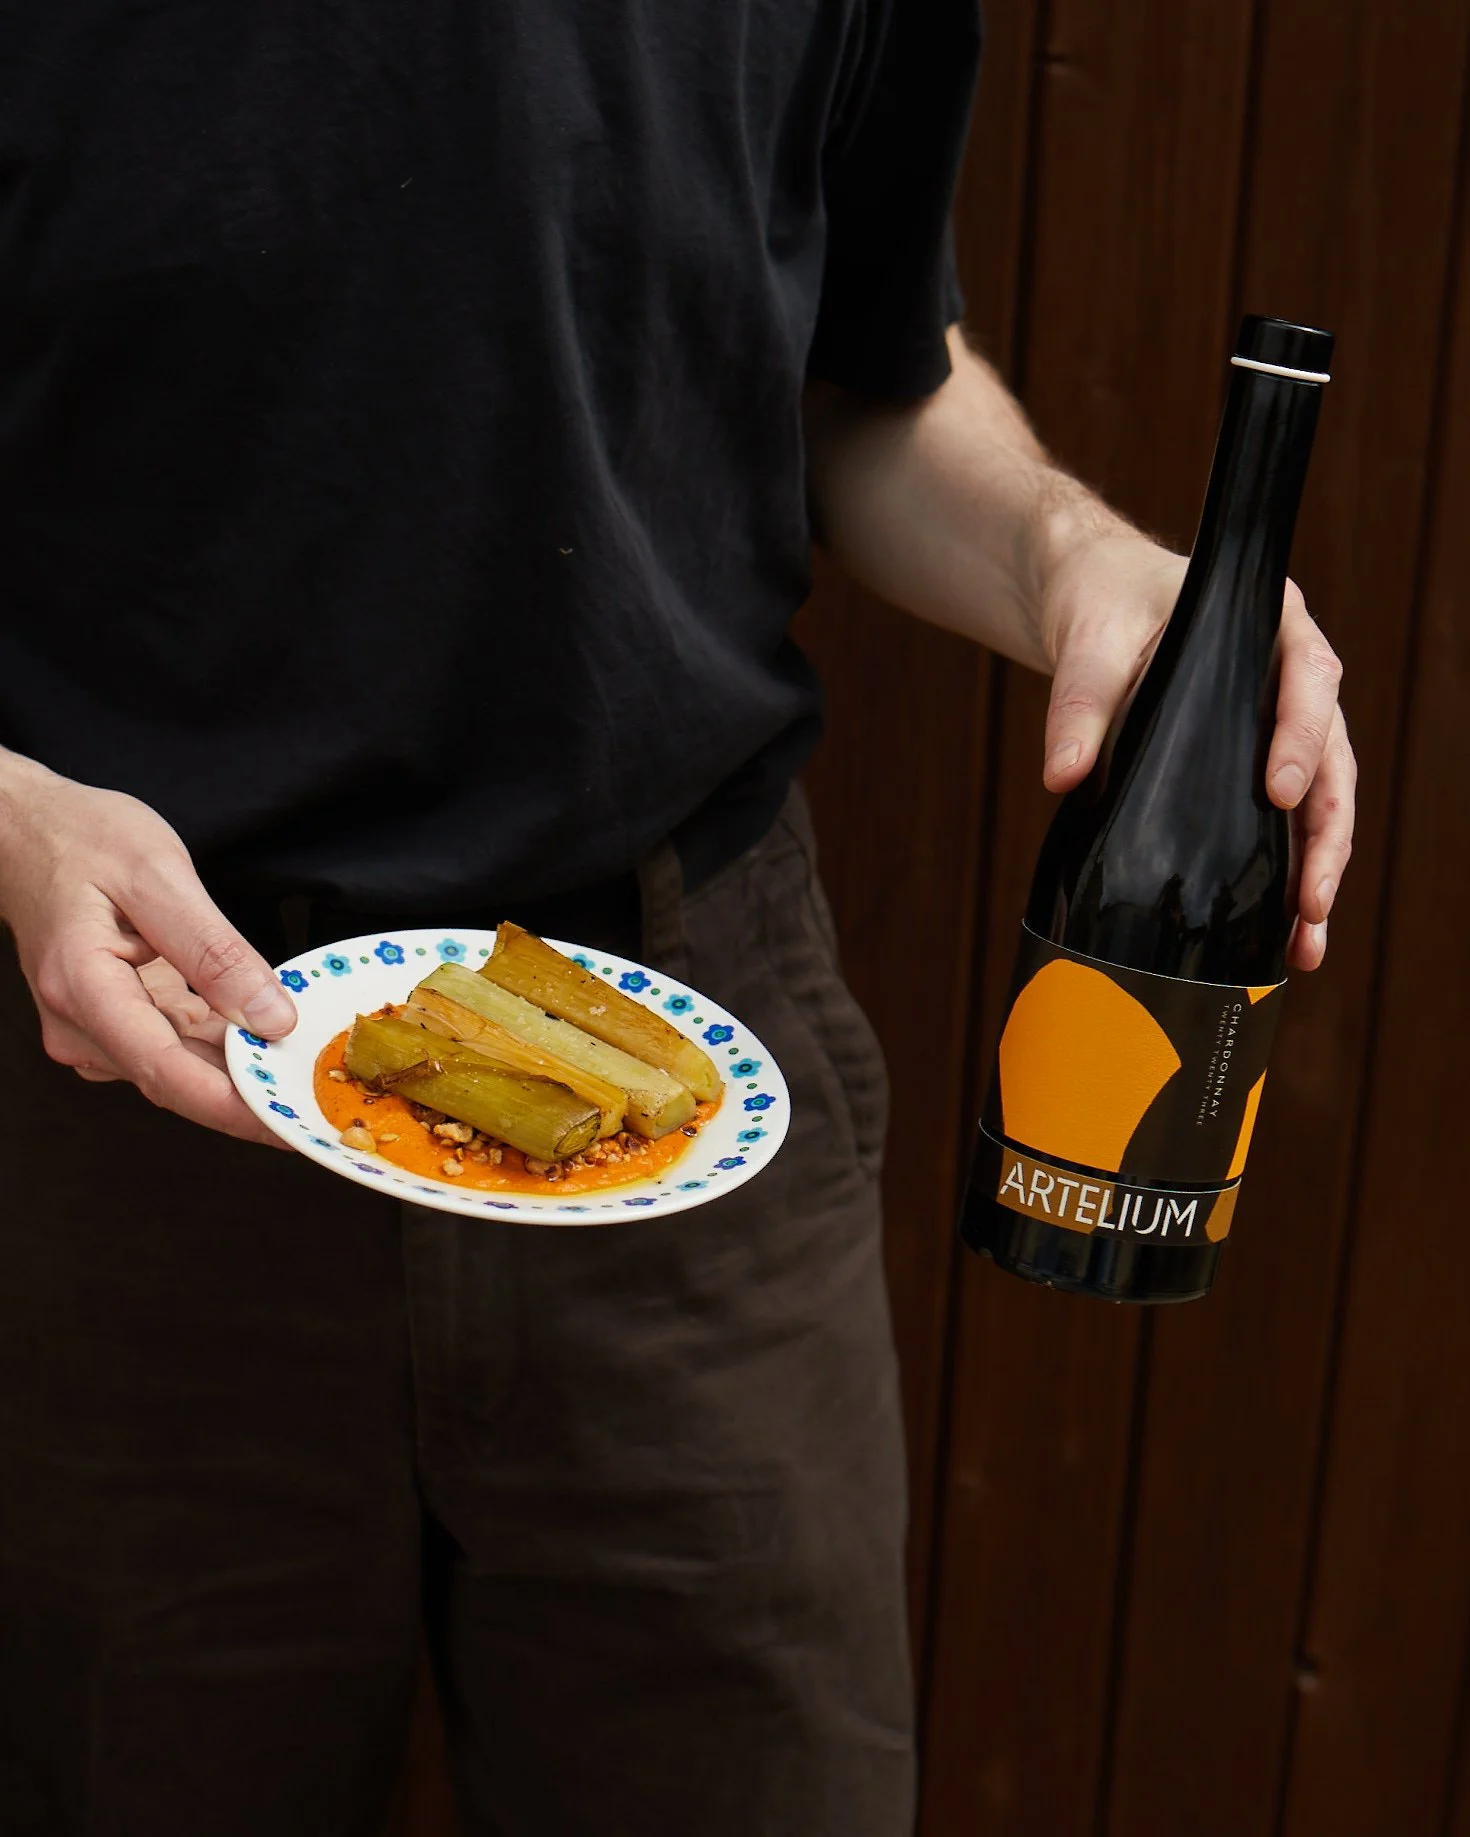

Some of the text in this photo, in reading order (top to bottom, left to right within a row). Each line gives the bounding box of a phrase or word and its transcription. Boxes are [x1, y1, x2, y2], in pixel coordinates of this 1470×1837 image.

[1196, 1005, 1230, 1126] TWENTY TWENTY THREE
[1209, 1003, 1242, 1117] CHARDONNAY
[999, 1162, 1198, 1237] ARTELIUM
